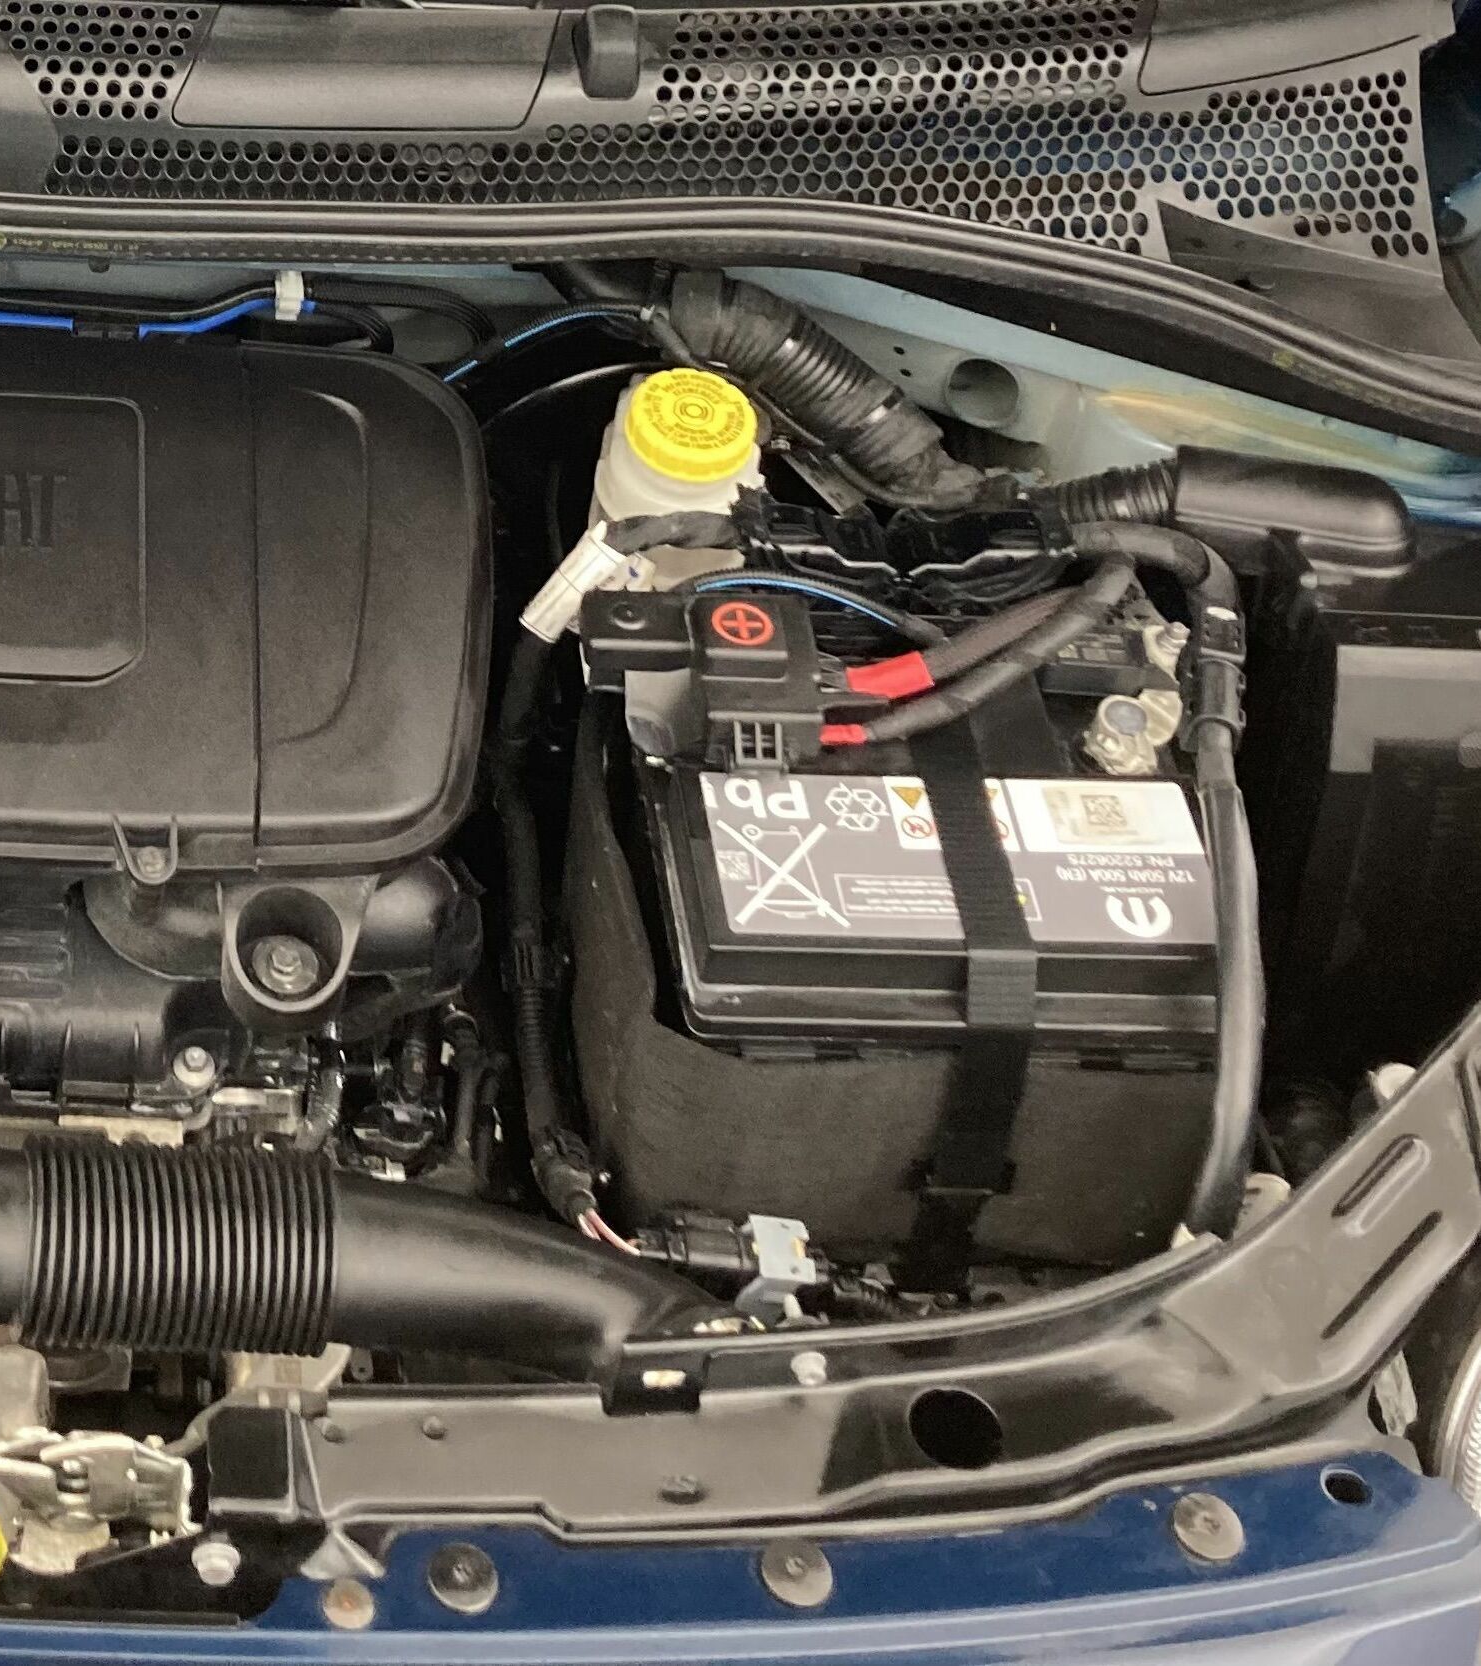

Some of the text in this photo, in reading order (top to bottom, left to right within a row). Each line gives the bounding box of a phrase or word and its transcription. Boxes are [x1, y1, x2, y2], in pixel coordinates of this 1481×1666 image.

[724, 777, 812, 819] Pb
[1086, 867, 1126, 882] 500A
[1126, 868, 1166, 883] 50Ah
[1167, 869, 1198, 883] 12V
